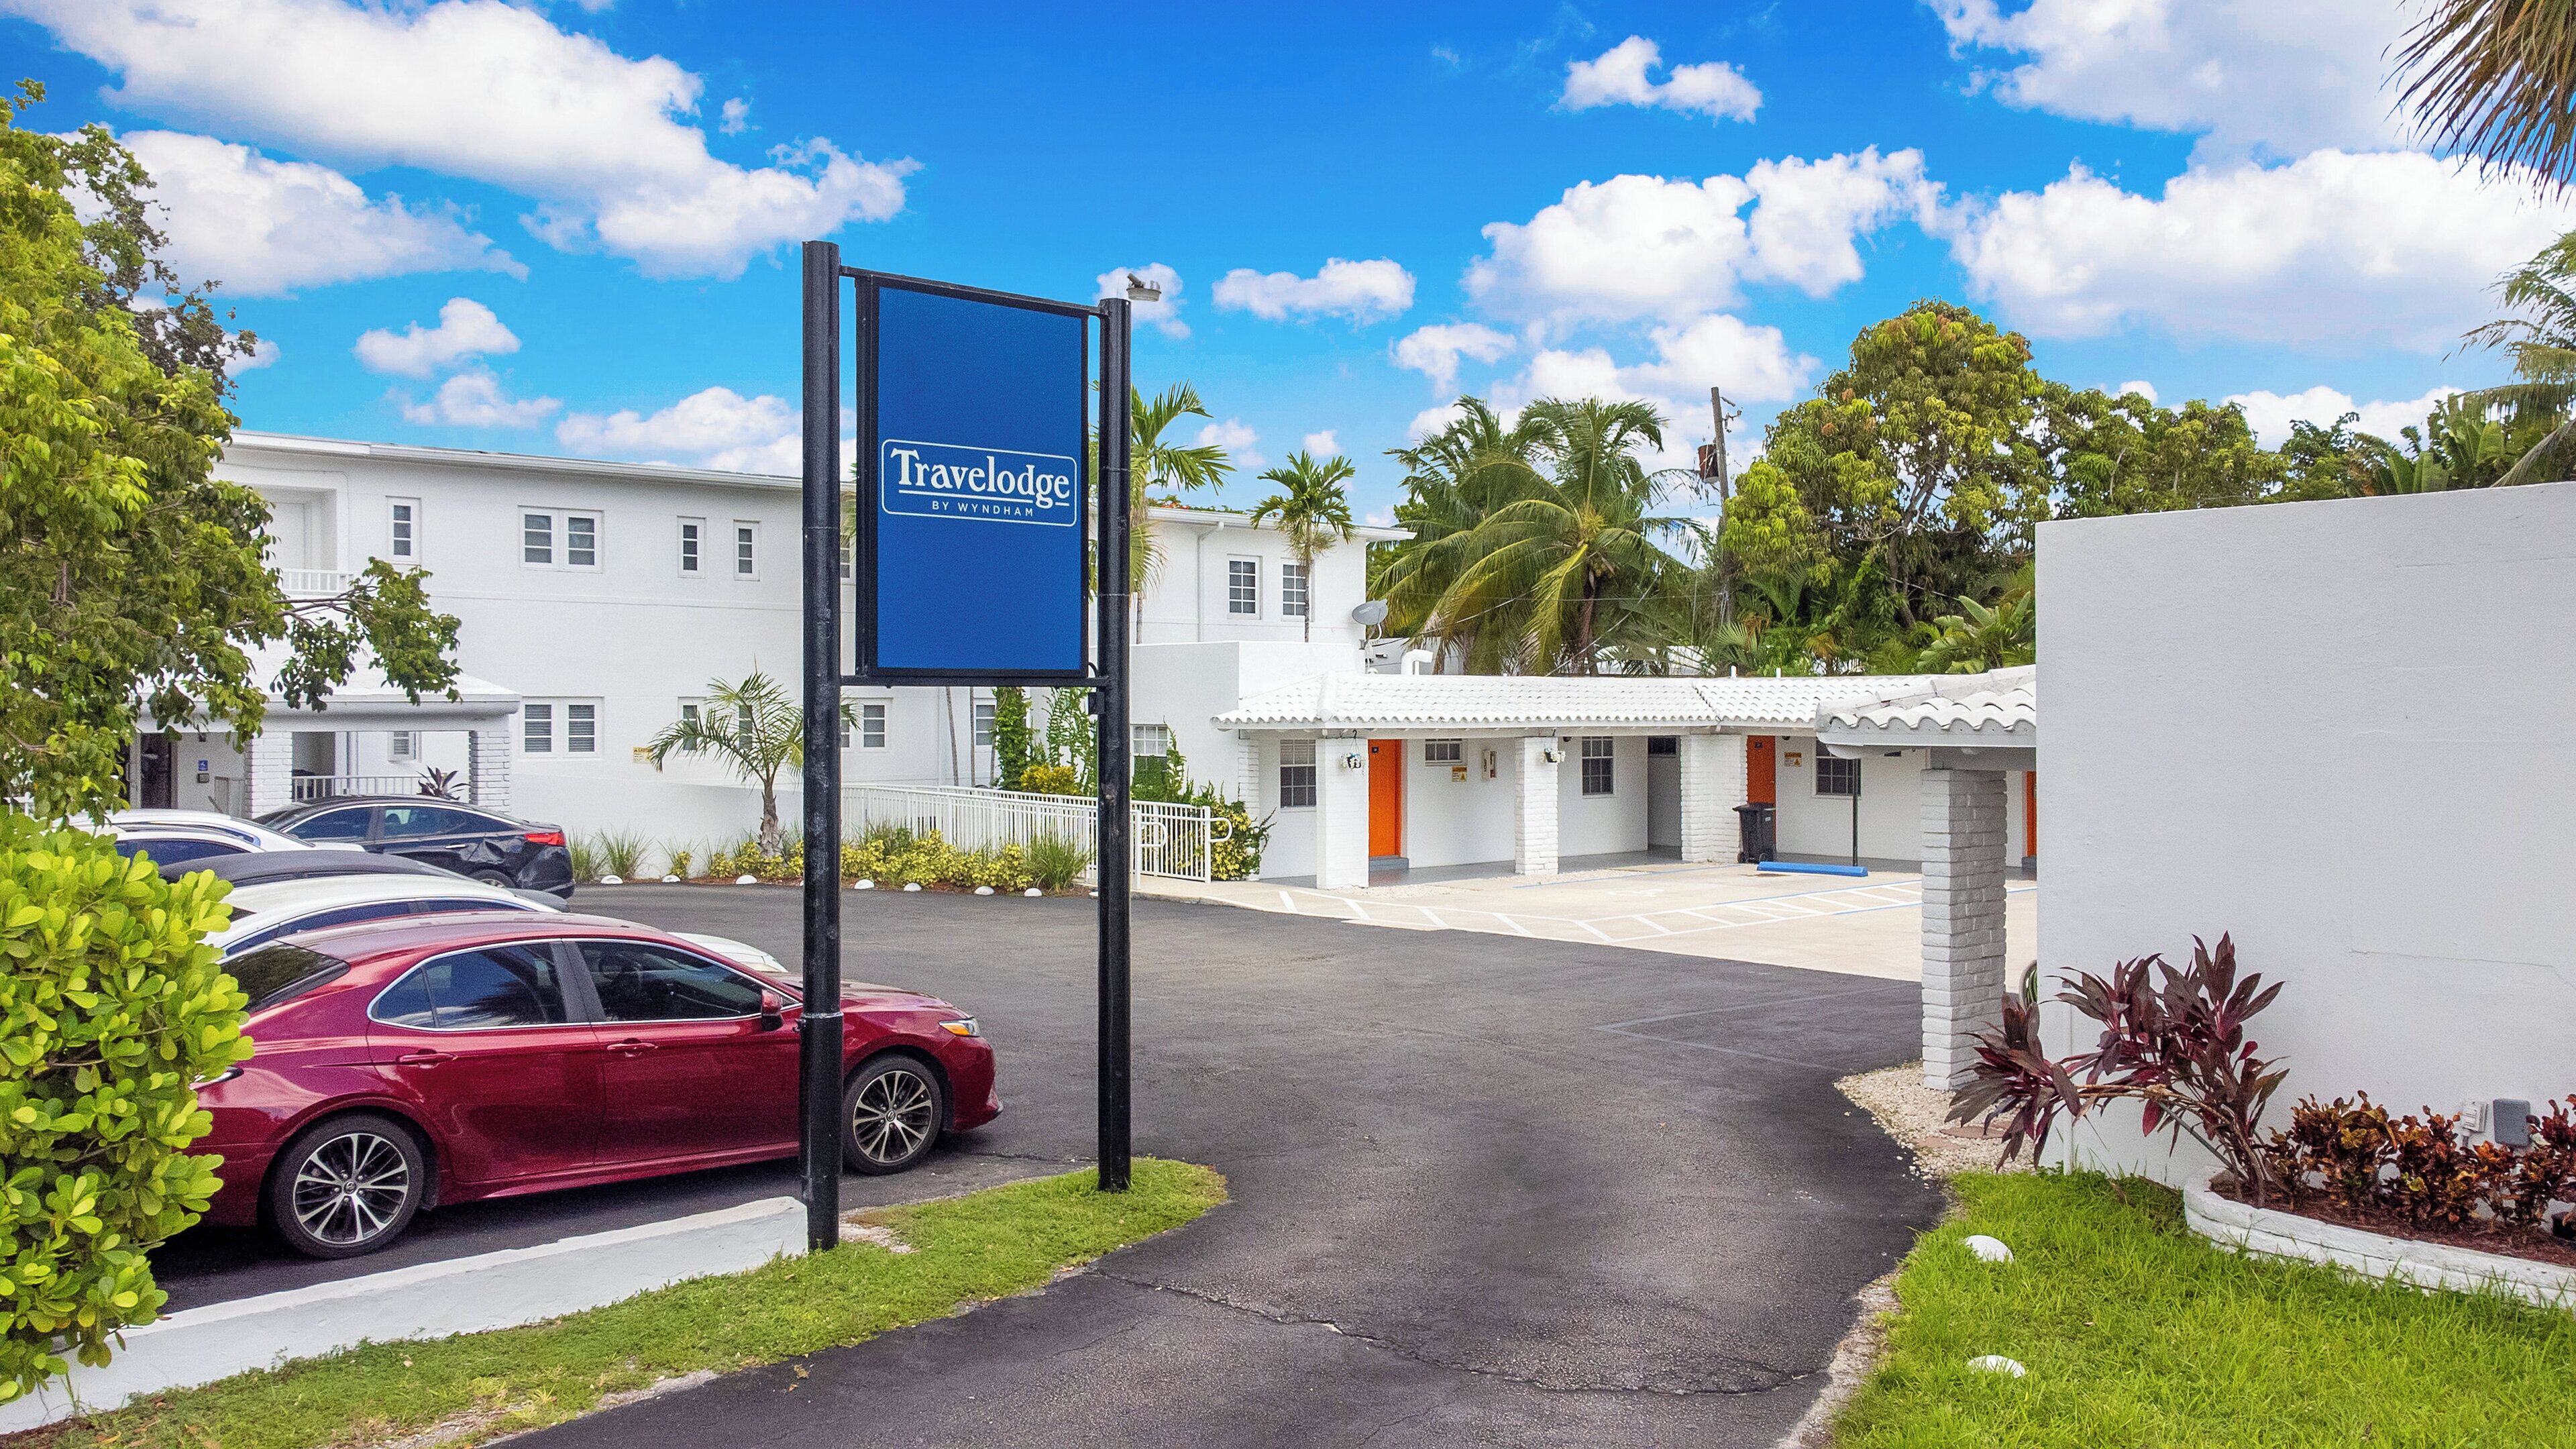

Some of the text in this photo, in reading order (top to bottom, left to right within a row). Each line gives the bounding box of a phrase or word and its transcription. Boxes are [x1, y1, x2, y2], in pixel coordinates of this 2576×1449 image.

[890, 447, 1070, 509] Travelodge
[932, 500, 1033, 517] BY WYNDHAM
